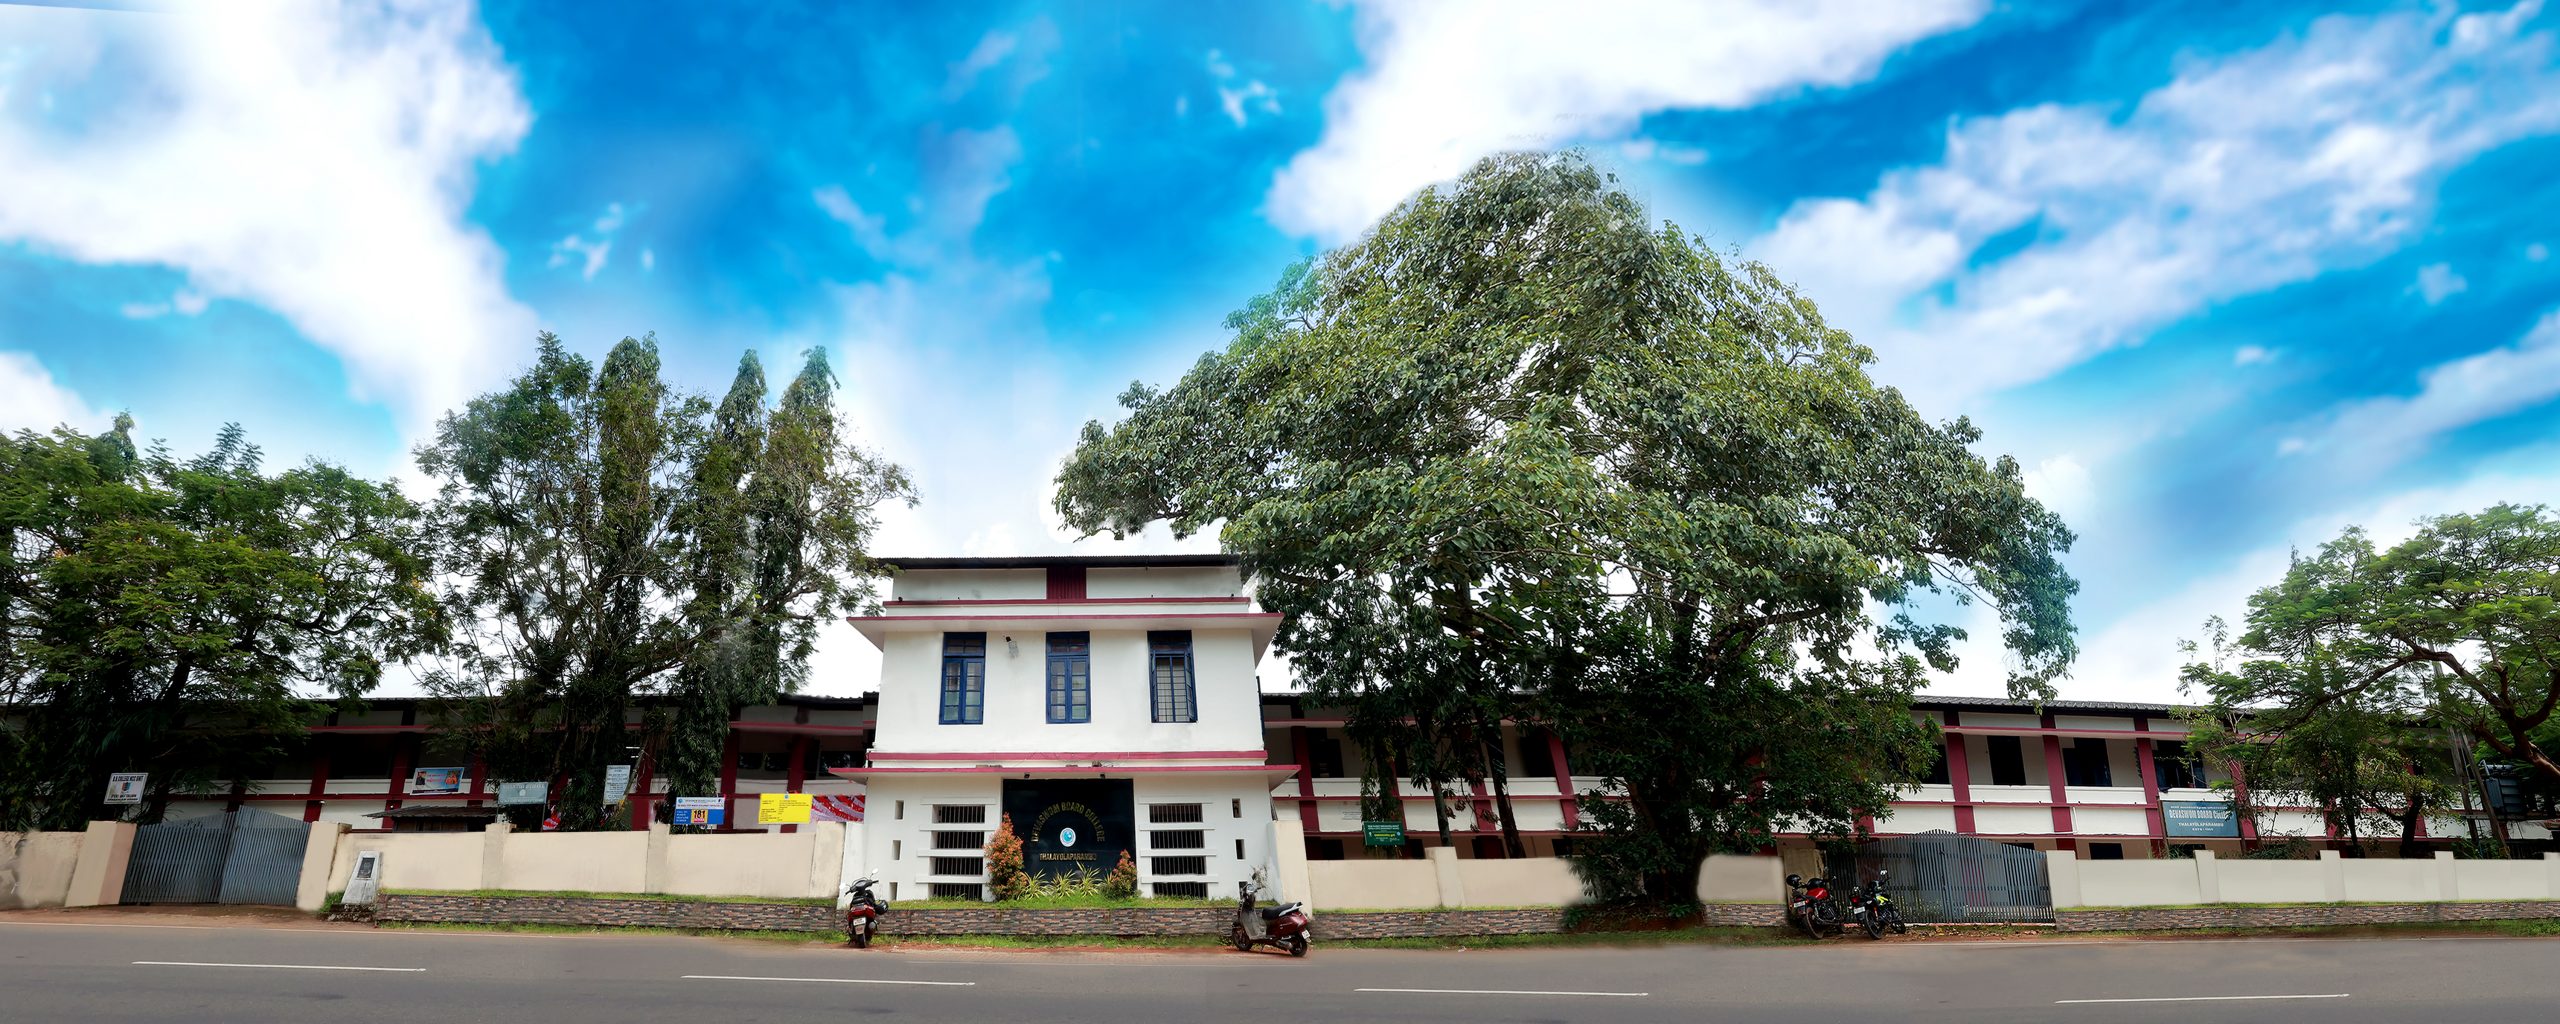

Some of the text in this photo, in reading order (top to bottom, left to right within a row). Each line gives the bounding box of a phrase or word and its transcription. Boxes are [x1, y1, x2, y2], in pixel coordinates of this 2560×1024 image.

[694, 810, 706, 819] 181
[2168, 809, 2197, 819] DEVASWOM
[2197, 809, 2213, 819] BOARD
[1031, 801, 1106, 842] DEVASWOM BOARD COLLEGE
